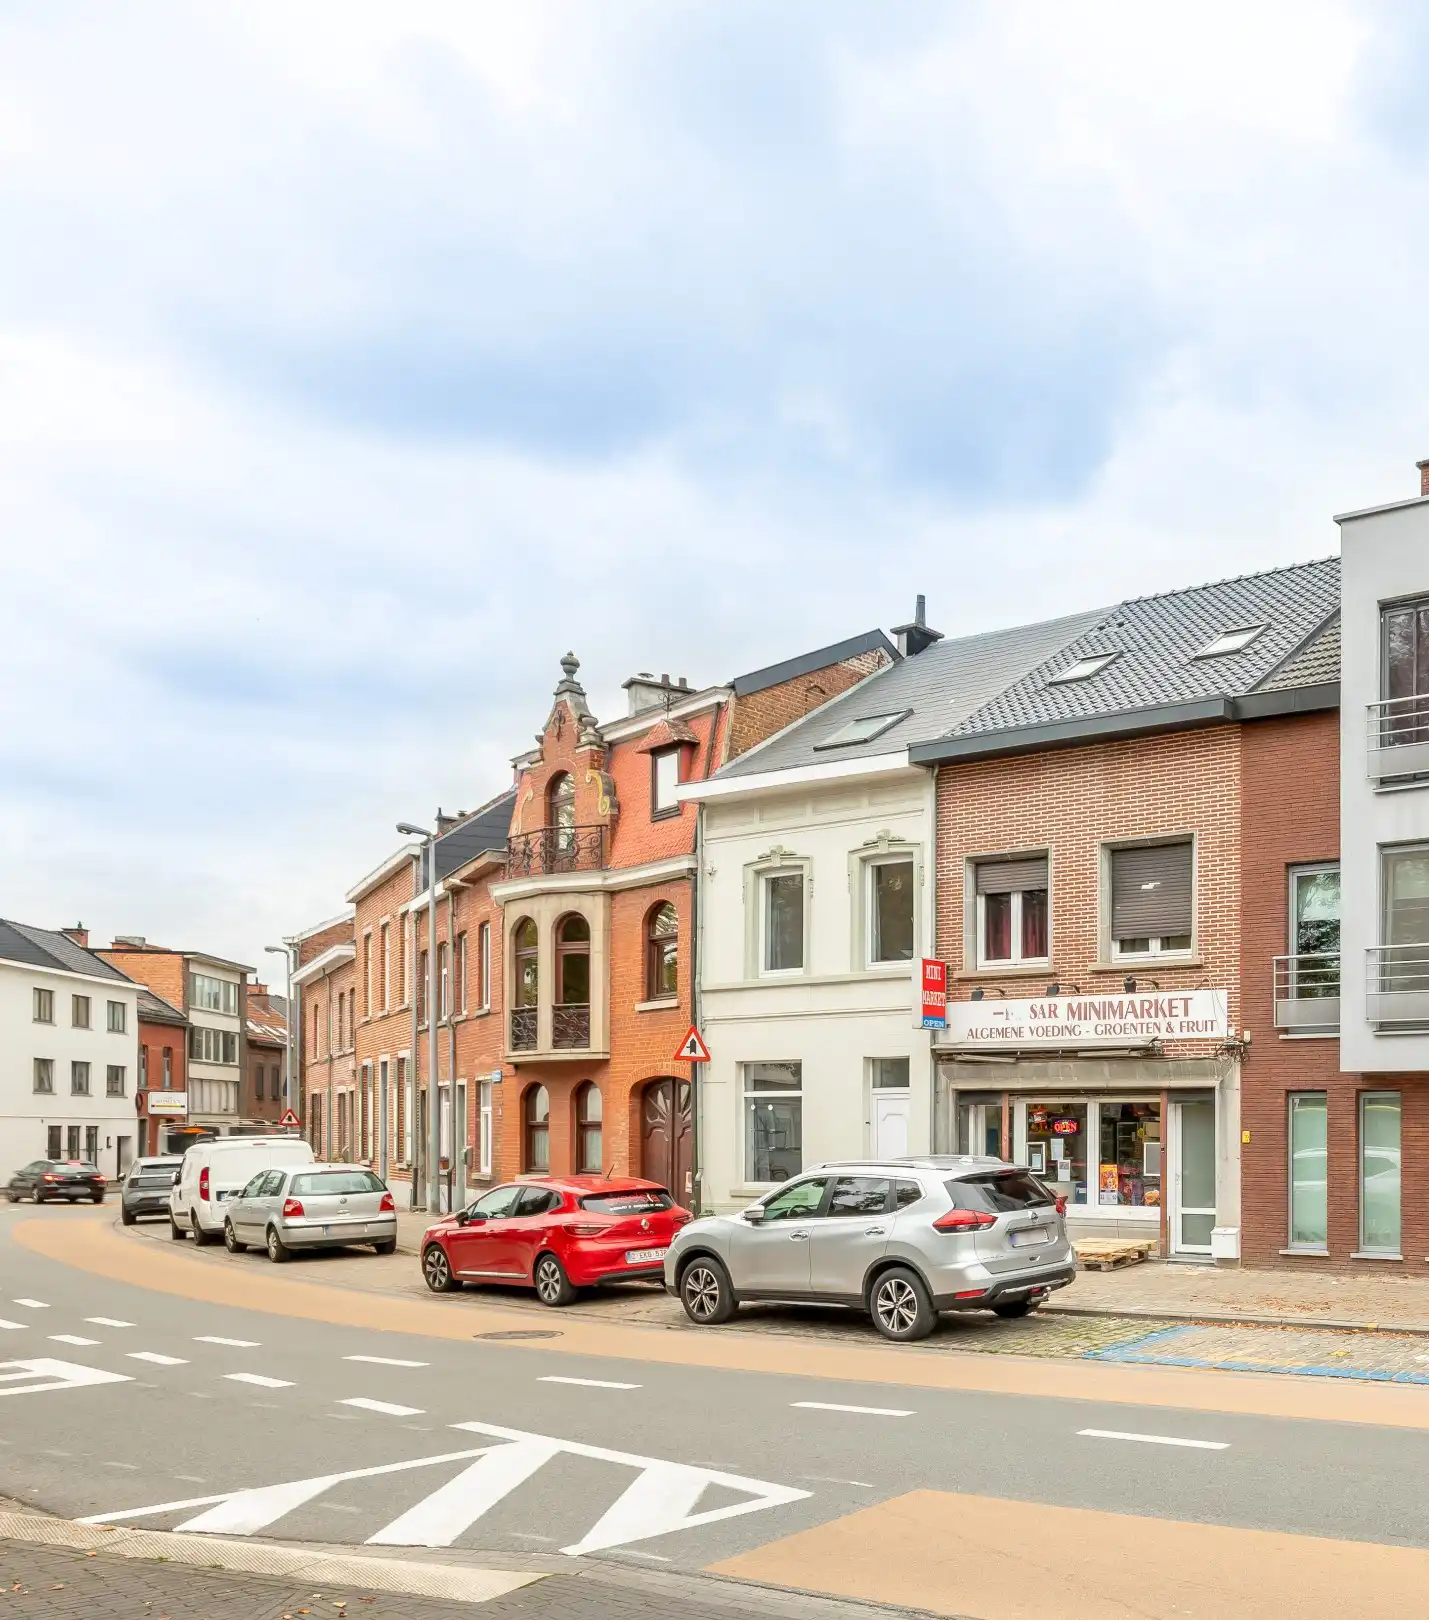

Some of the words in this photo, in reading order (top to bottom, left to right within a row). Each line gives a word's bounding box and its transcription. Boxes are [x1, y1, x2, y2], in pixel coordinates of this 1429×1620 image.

[925, 965, 942, 980] MINI
[922, 990, 946, 1007] MARKET
[1029, 1003, 1059, 1020] SAR
[1066, 997, 1193, 1021] MINIMARKET
[923, 1019, 945, 1028] OPEN
[966, 1026, 1025, 1040] ALGEMENE
[1028, 1024, 1082, 1038] VOEDING
[1094, 1021, 1161, 1036] GROENTEN
[1165, 1021, 1175, 1034] &
[1179, 1019, 1217, 1033] FRUIT
[1054, 1121, 1077, 1133] OPEN
